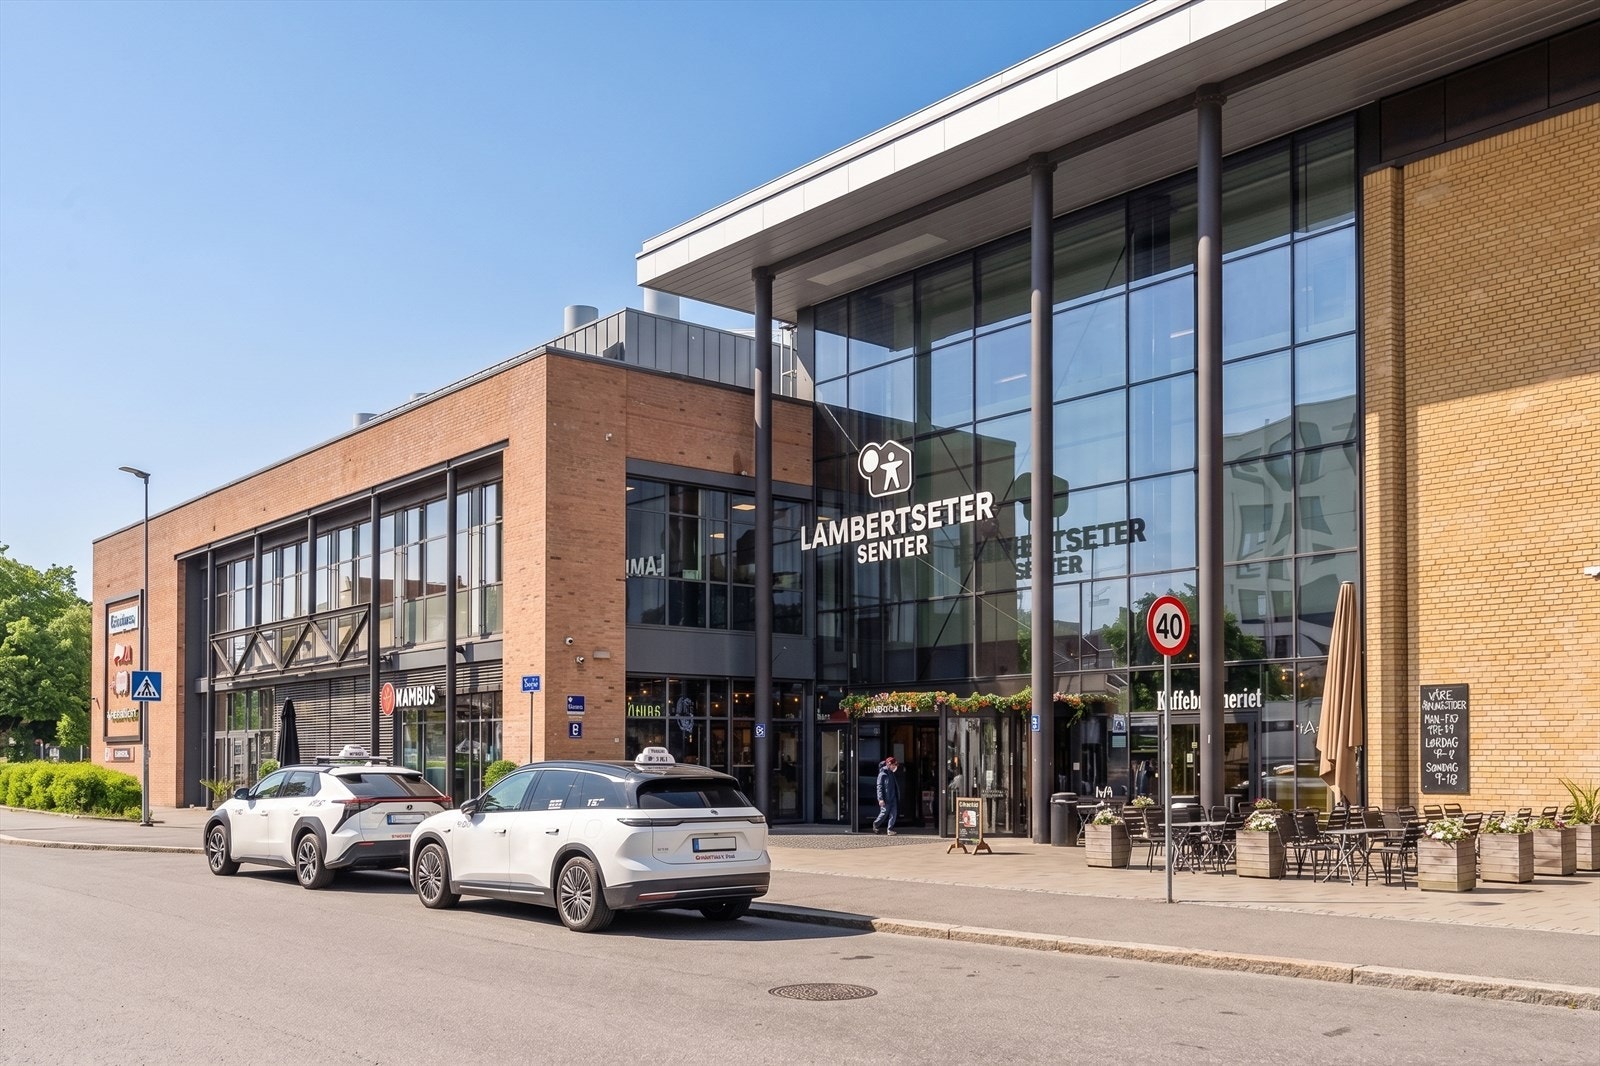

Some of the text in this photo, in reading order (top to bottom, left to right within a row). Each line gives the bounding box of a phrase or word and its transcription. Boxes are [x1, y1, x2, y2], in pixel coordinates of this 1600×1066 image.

[800, 491, 994, 551] LAMBERTSETER
[857, 534, 929, 564] SENTER
[1156, 613, 1183, 640] 40
